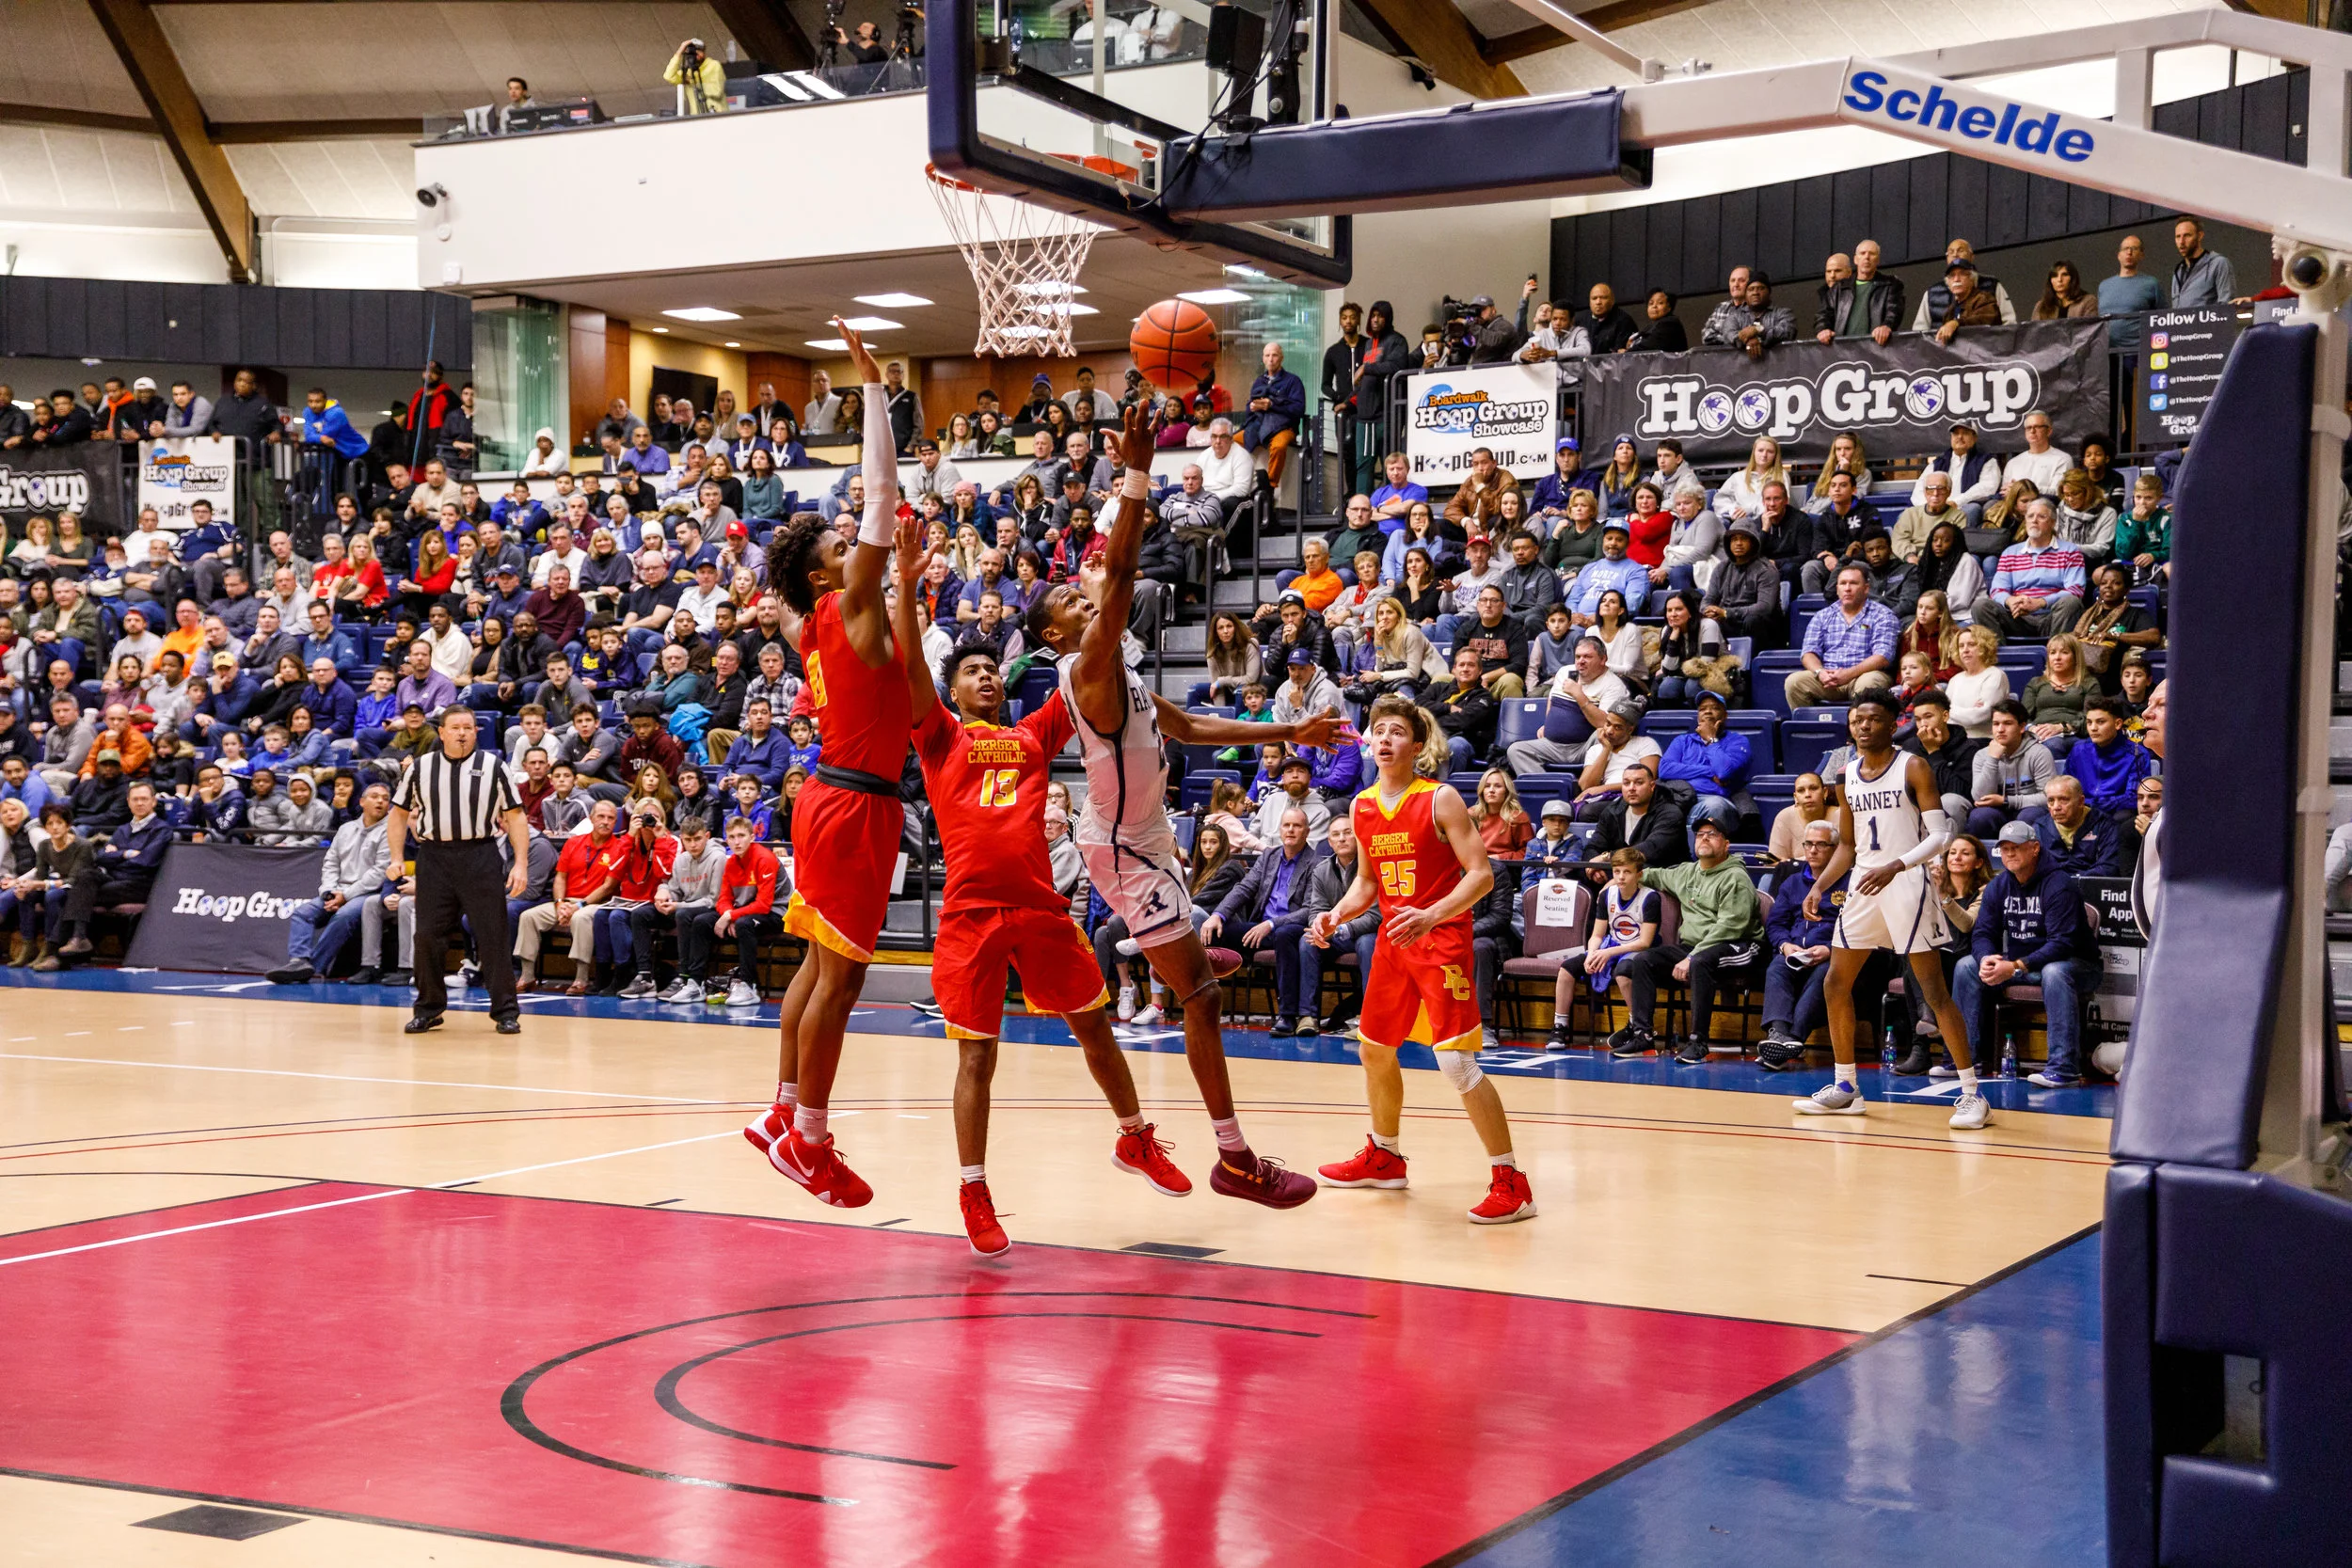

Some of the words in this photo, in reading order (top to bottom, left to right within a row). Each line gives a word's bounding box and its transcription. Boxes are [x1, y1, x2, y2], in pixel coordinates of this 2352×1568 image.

[1844, 71, 2094, 163] Schelde
[2150, 313, 2196, 327] Follow
[2199, 310, 2228, 324] Us...
[2272, 307, 2293, 318] Find
[2170, 332, 2213, 343] @HoopGroup
[2169, 352, 2224, 364] @TheHoopGroup
[1428, 390, 1488, 407] Boardwalk
[1416, 405, 1476, 430] Hoop
[1477, 400, 1549, 422] Group
[2161, 415, 2197, 427] Hoop
[1472, 420, 1543, 437] Showcase
[973, 739, 1021, 752] BERGEN
[967, 752, 1027, 764] CATHOLIC
[979, 768, 1020, 807] 13
[1848, 789, 1902, 813] RANNEY
[1372, 832, 1409, 847] BERGEN
[1867, 816, 1881, 851] 1
[1368, 843, 1415, 858] CATHOLIC
[1379, 859, 1417, 897] 25
[1543, 894, 1571, 902] Reserved
[2101, 889, 2127, 902] Find
[1544, 904, 1568, 913] Seating
[2108, 907, 2133, 922] App
